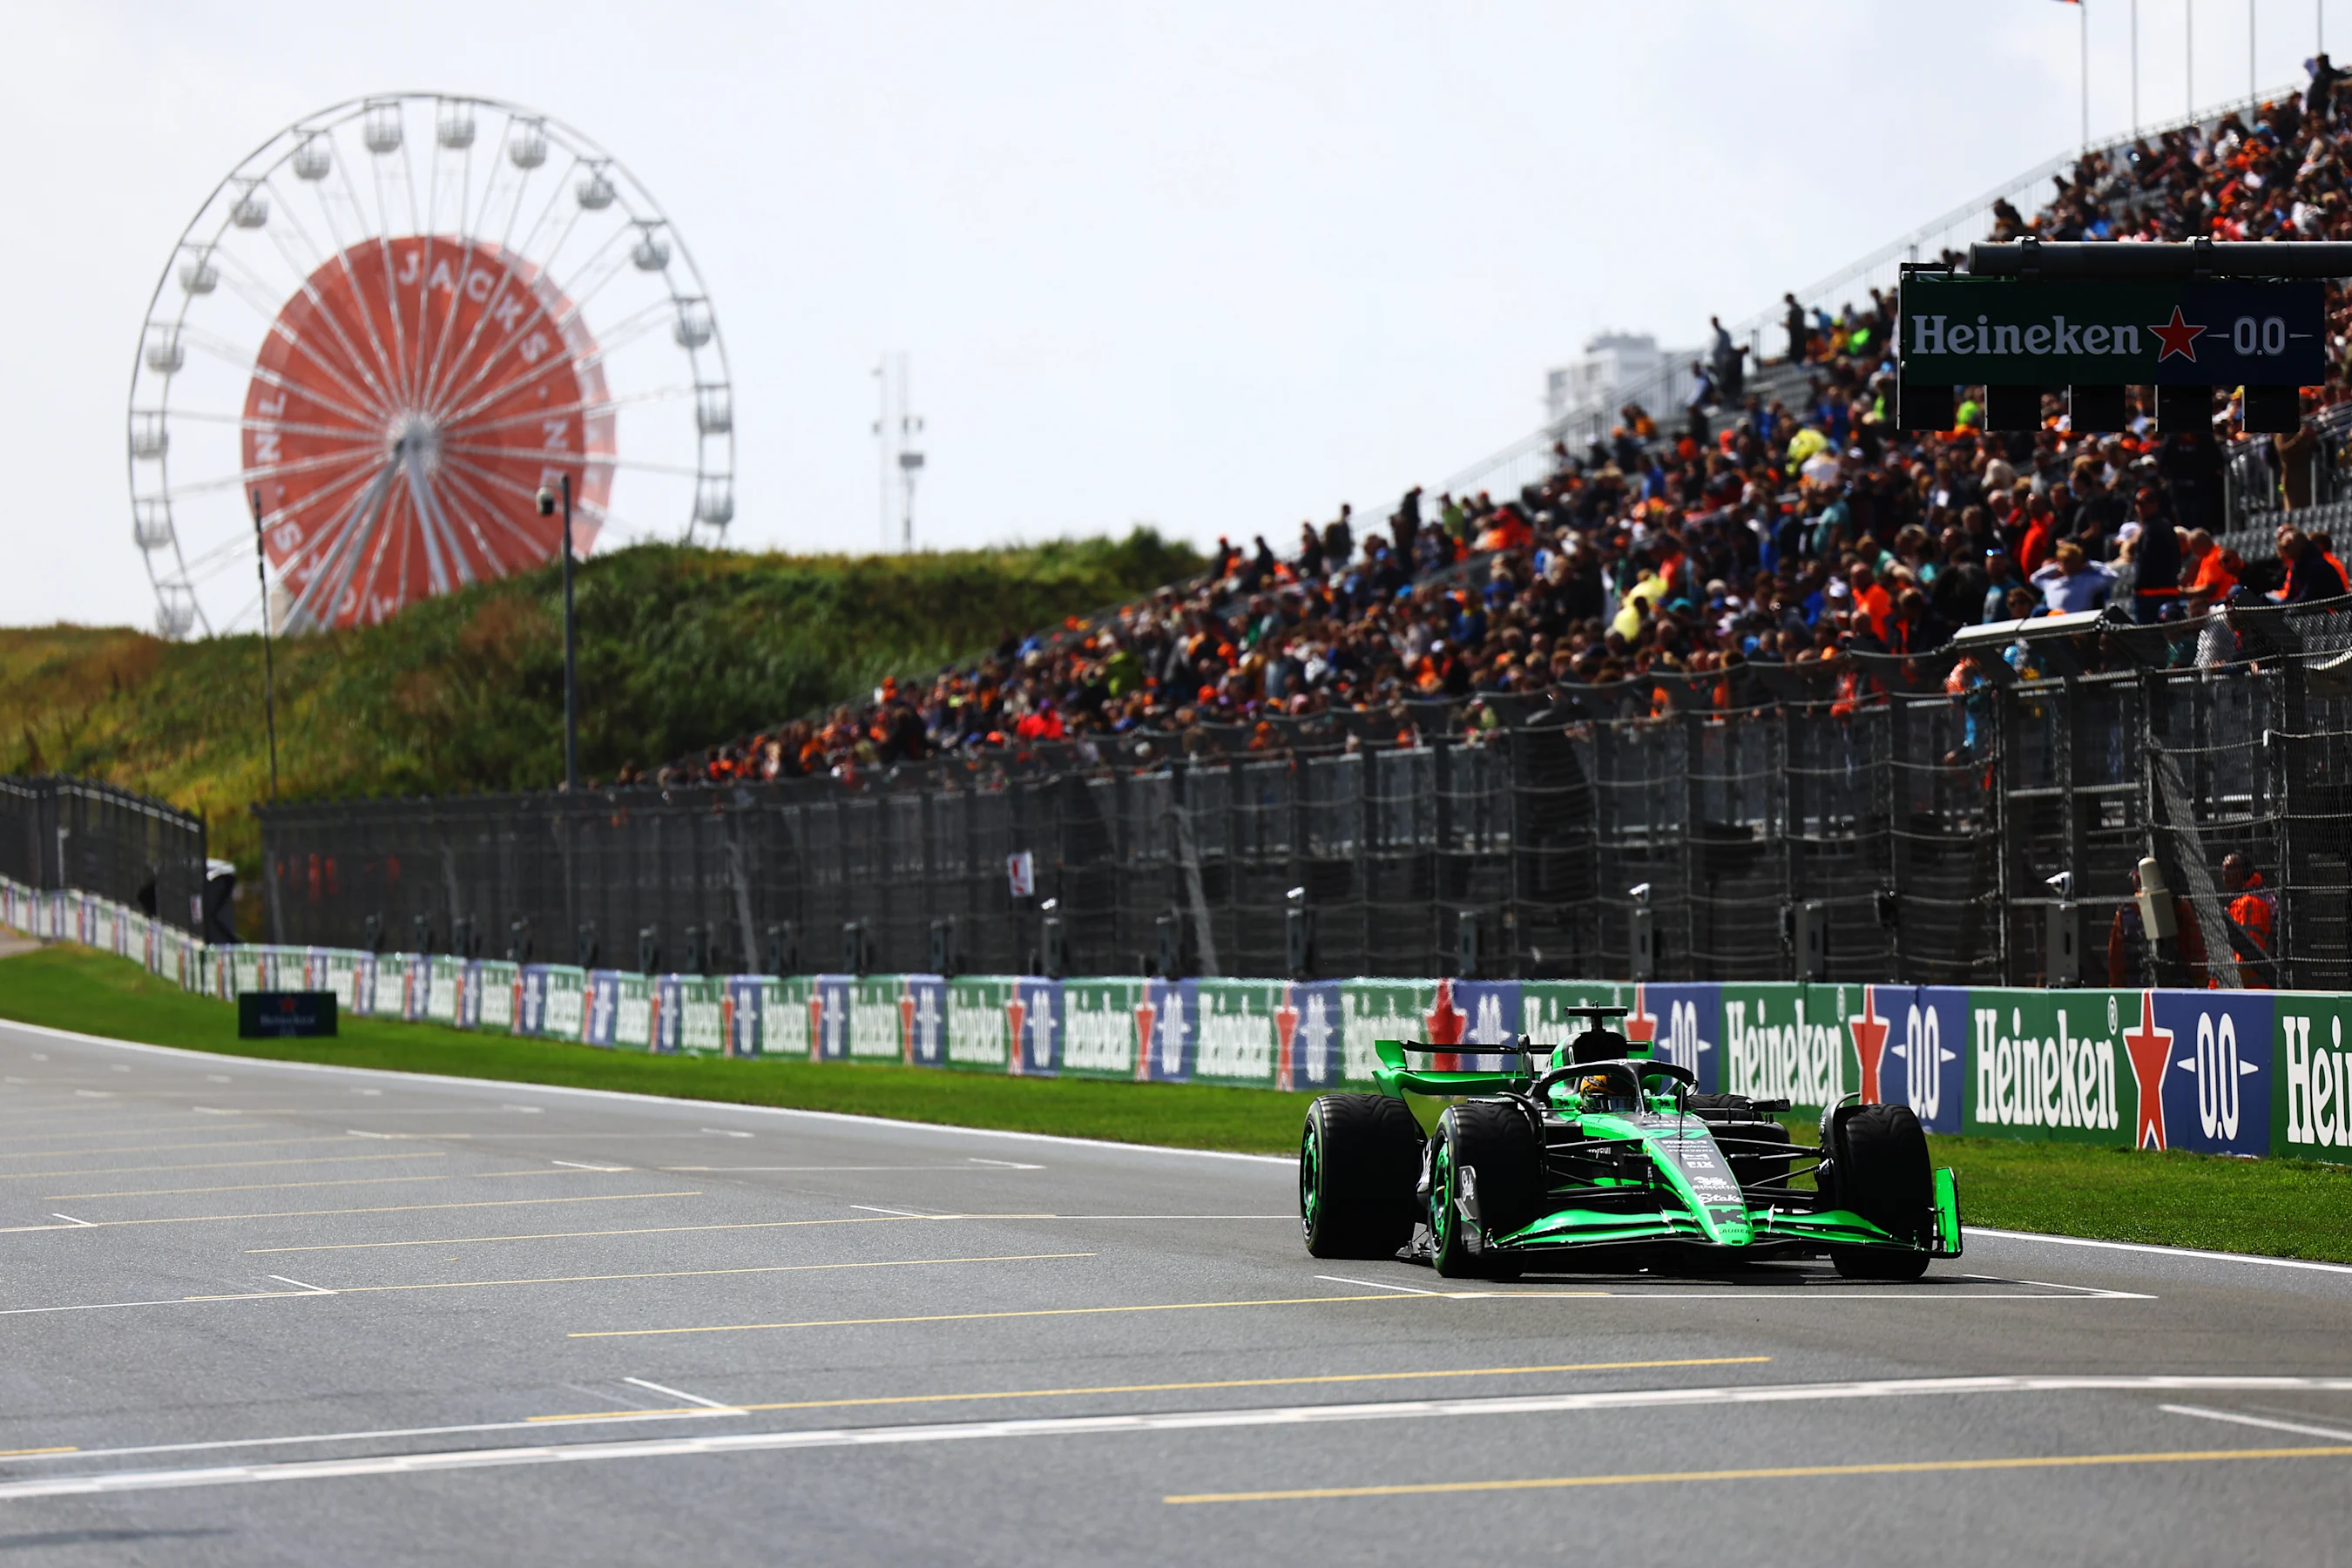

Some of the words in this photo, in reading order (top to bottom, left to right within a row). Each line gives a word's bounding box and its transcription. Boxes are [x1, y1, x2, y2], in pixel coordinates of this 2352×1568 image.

[1911, 314, 2142, 355] Heineken
[2233, 315, 2286, 356] 0.0
[1906, 1004, 1940, 1120] 0.0
[2197, 1011, 2240, 1141] 0.0
